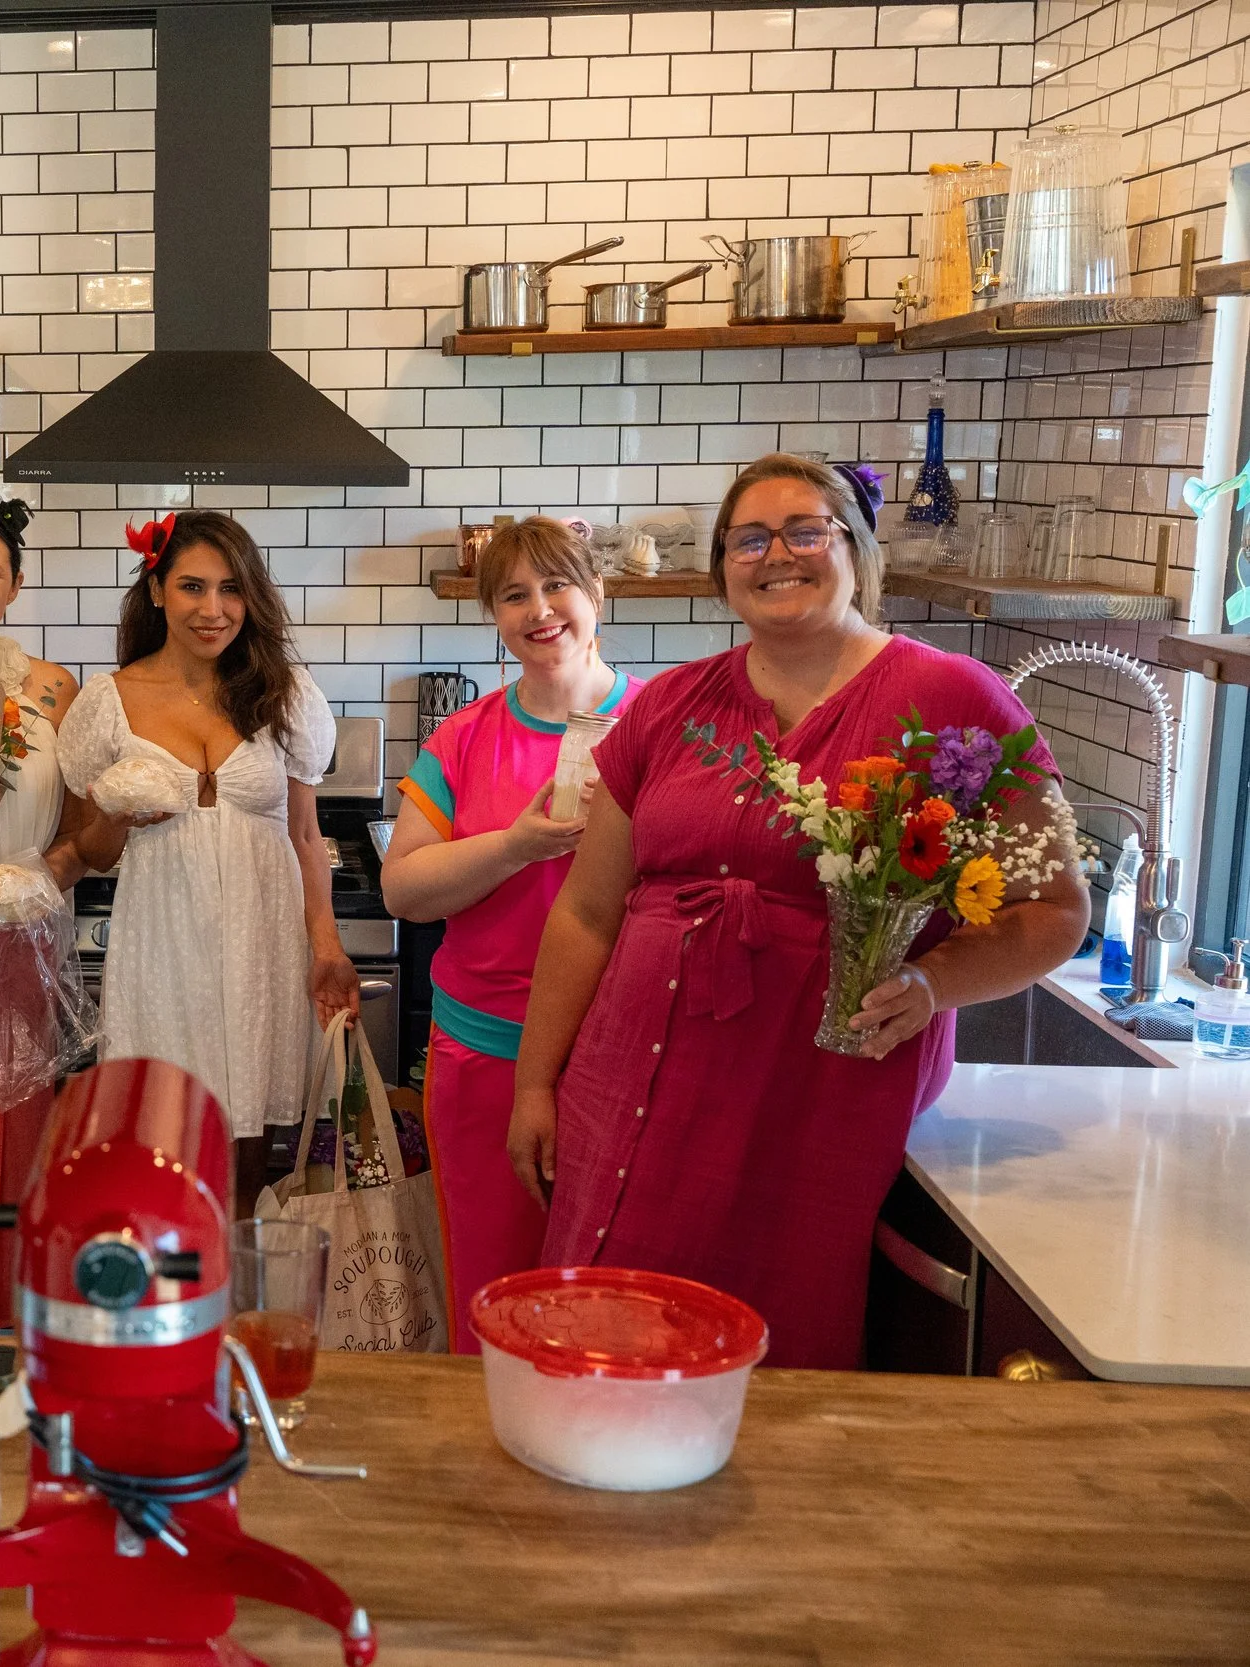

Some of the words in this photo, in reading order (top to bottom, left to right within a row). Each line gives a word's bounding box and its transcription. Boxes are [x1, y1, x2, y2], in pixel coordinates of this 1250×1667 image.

[381, 1231, 388, 1241] A
[391, 1231, 411, 1244] MOM
[337, 1327, 397, 1351] Social
[399, 1310, 438, 1347] Club
